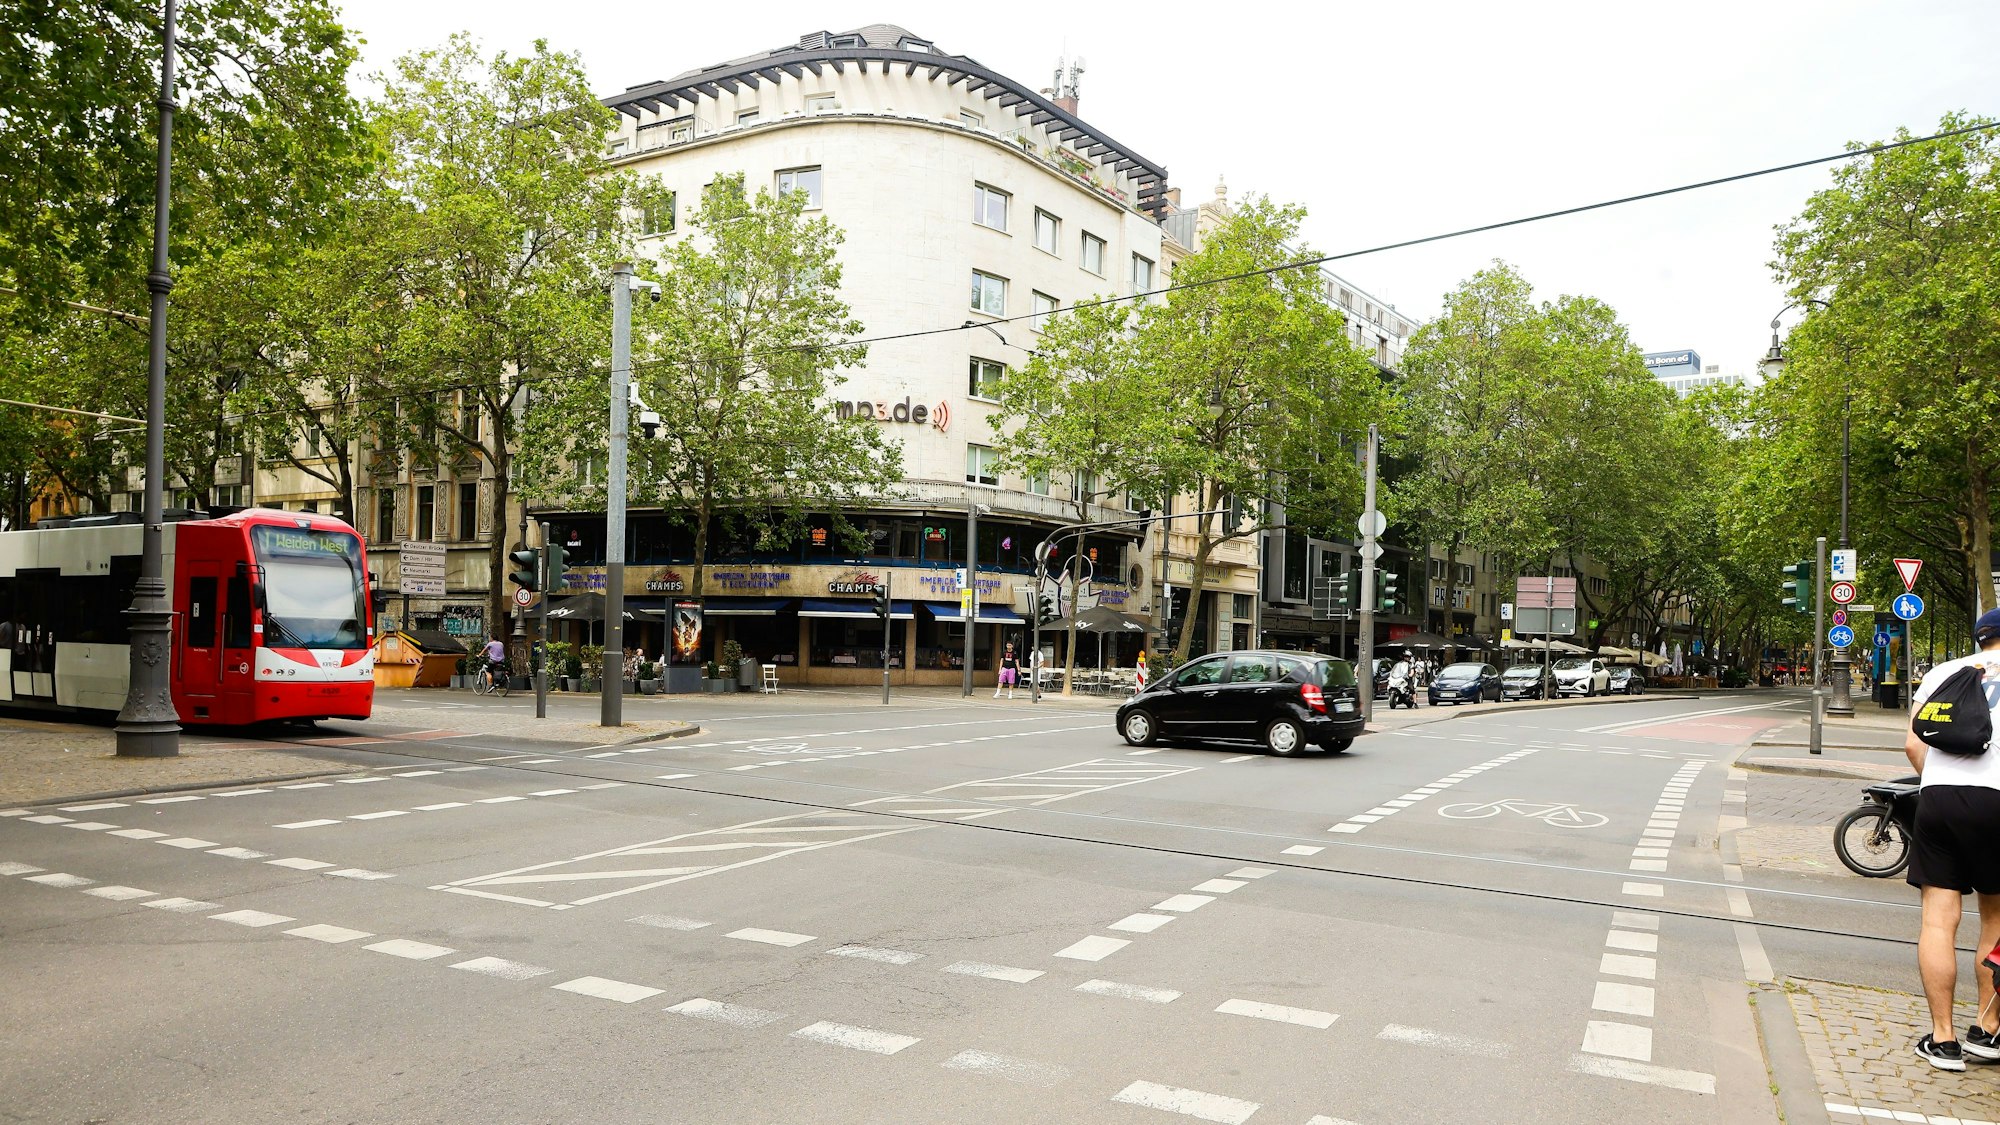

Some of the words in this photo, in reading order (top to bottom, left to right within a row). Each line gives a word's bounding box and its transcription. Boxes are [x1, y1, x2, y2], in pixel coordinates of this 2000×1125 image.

[1655, 355, 1677, 364] Bonn
[276, 533, 317, 551] Weiden
[319, 538, 349, 553] West
[646, 581, 682, 590] CHAMPS
[519, 591, 529, 601] 30
[1836, 588, 1850, 598] 30
